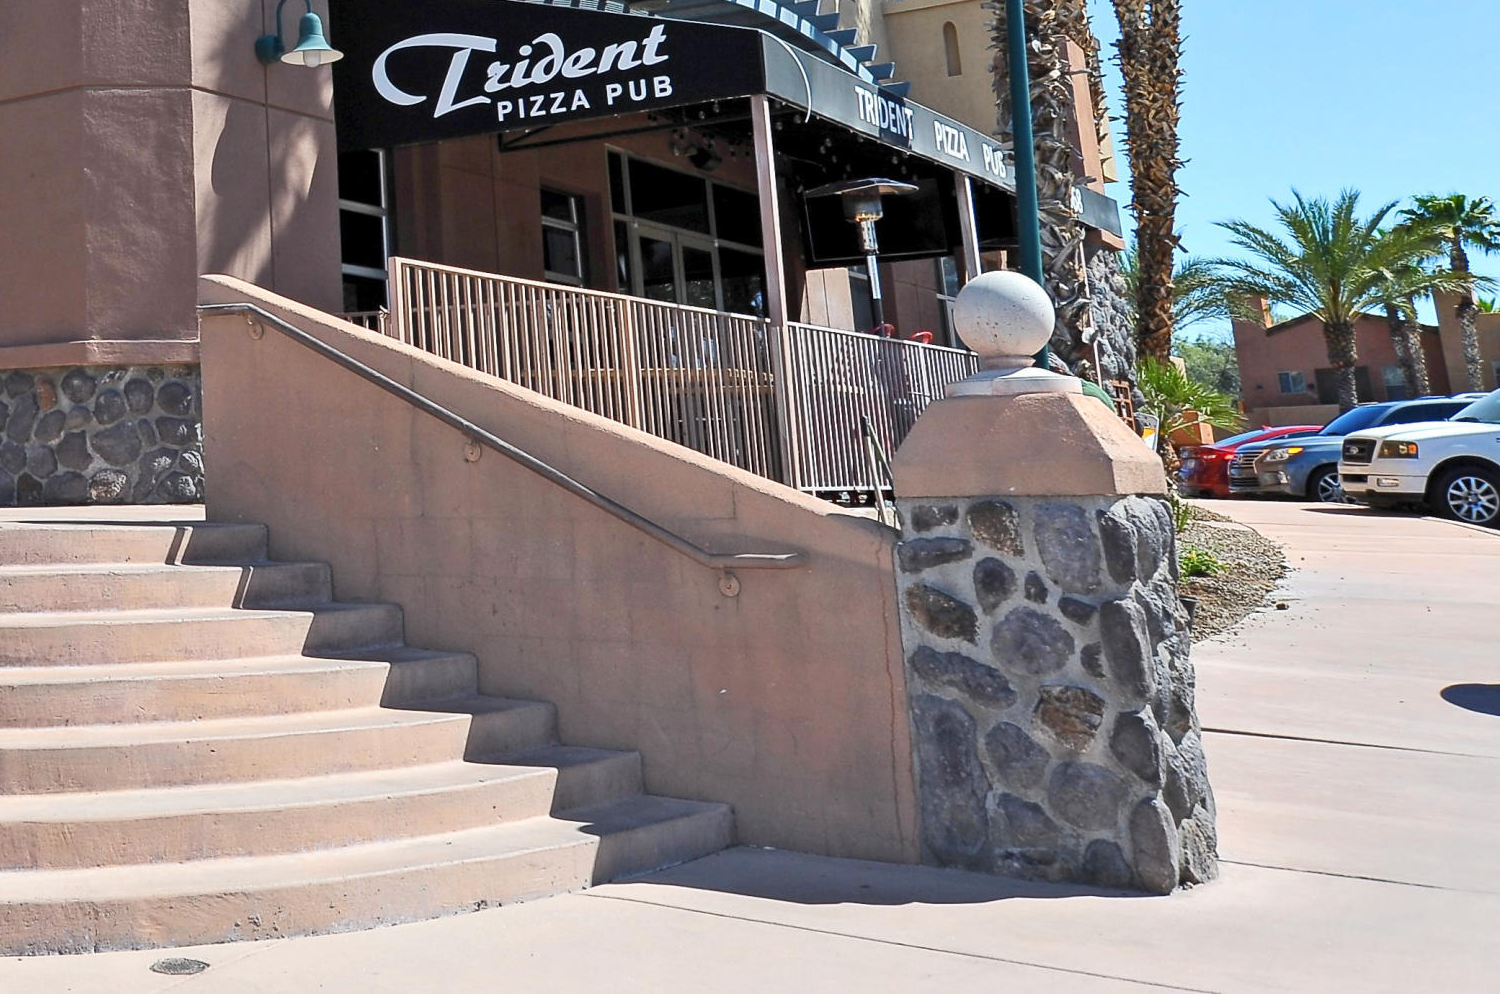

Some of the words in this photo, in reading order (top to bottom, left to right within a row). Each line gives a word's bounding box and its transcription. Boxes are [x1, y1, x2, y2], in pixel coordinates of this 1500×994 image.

[372, 24, 669, 119] Trident
[497, 88, 591, 122] PIZZA
[606, 75, 673, 106] PUB
[854, 85, 914, 140] TRIDENT
[933, 120, 970, 162] PIZZA
[982, 143, 1007, 179] PUB
